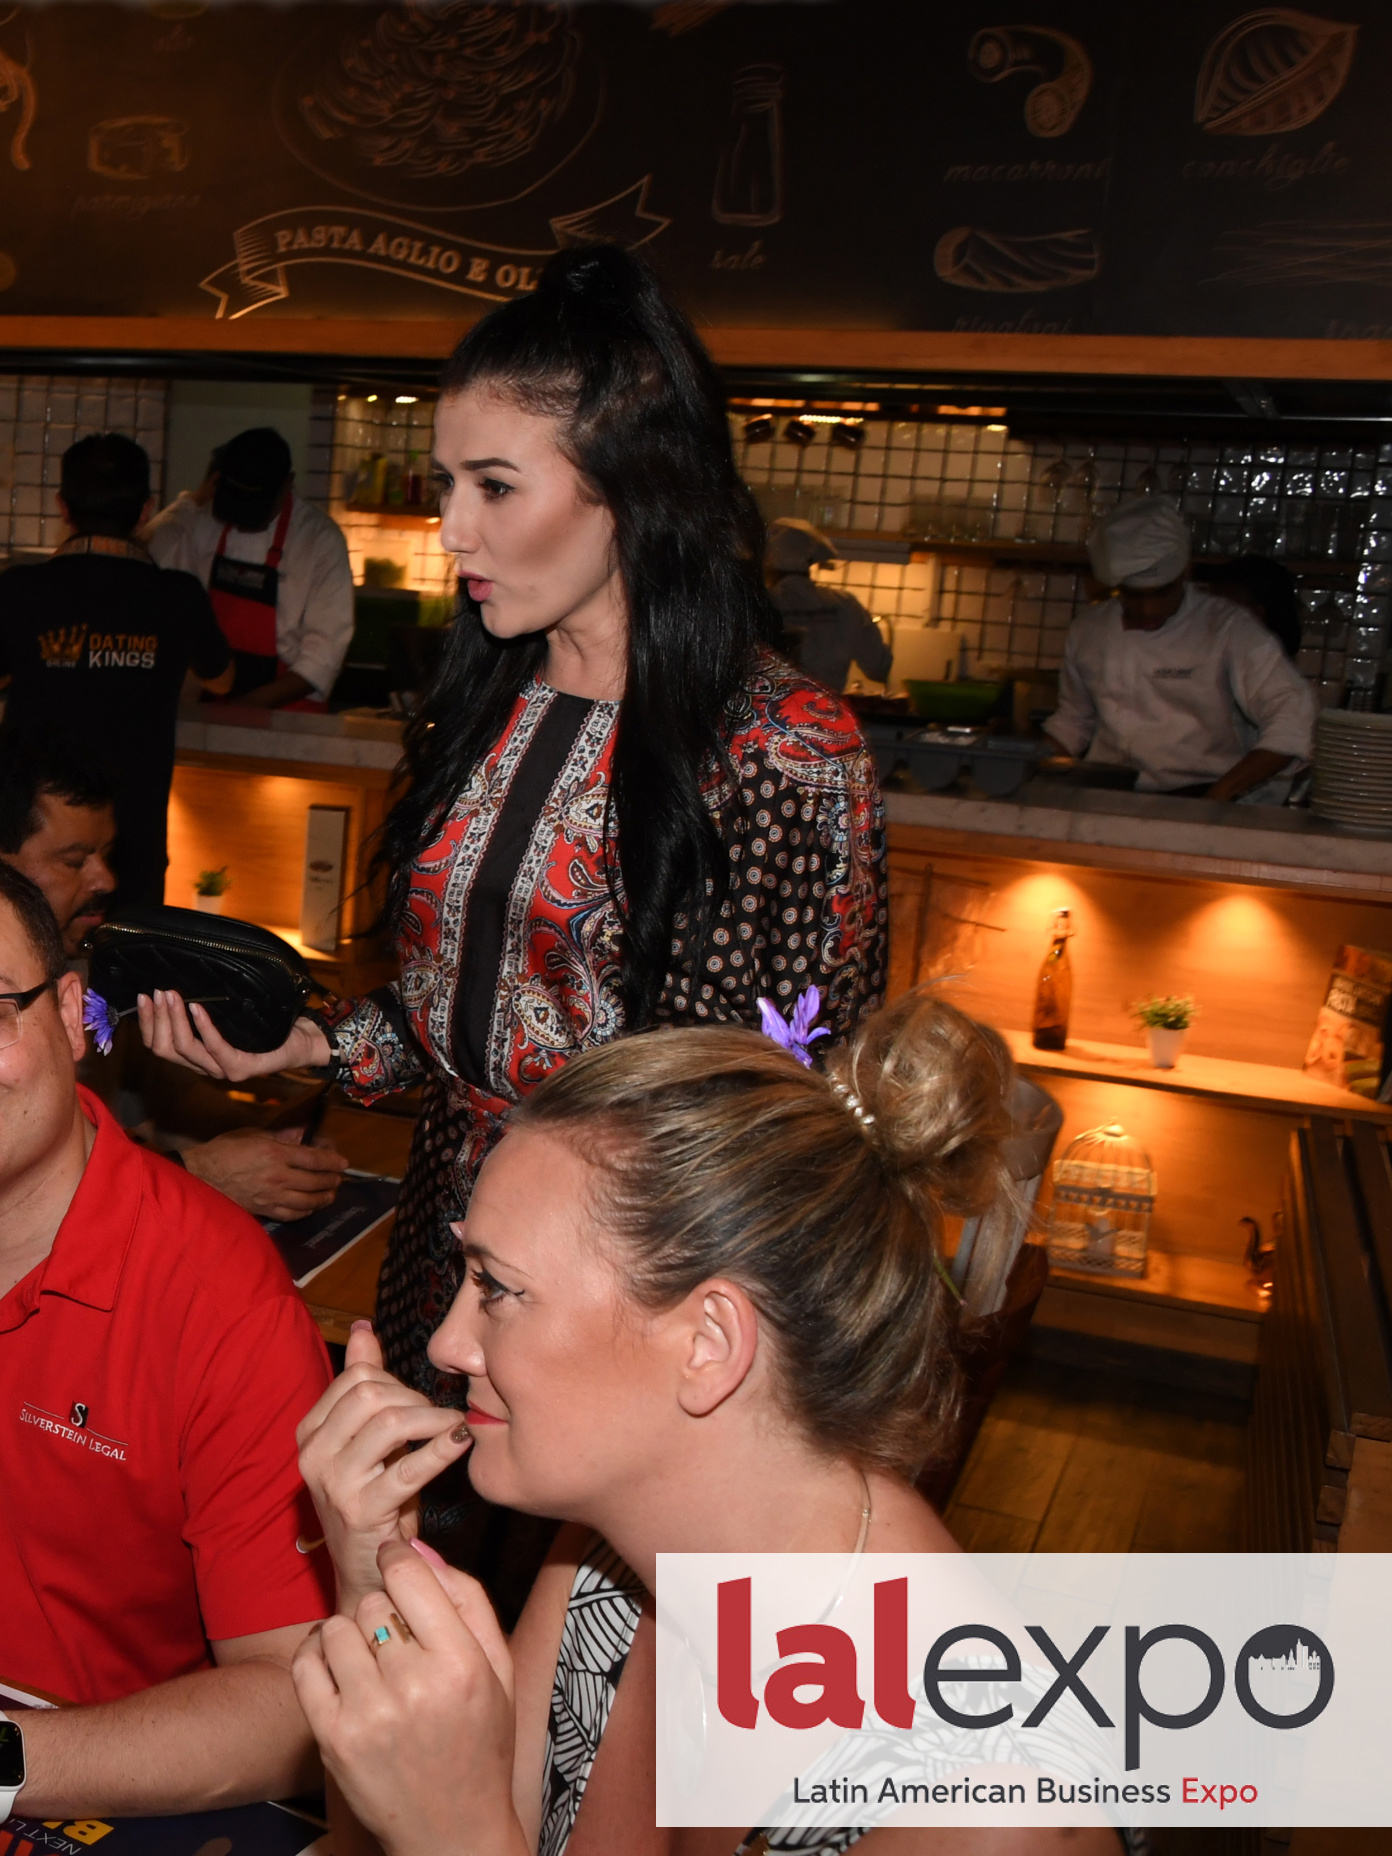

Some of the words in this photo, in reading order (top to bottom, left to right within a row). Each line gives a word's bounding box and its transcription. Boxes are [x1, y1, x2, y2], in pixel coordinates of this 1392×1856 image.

[273, 224, 366, 254] PASTA
[366, 231, 463, 275] AGLIO
[465, 256, 492, 283] E
[495, 263, 544, 292] OL
[88, 632, 159, 653] DATING
[88, 650, 157, 670] KINGS
[19, 1408, 88, 1447] SILVERSTEIN
[88, 1438, 127, 1462] LEGAL
[22, 1827, 82, 1856] NEXT
